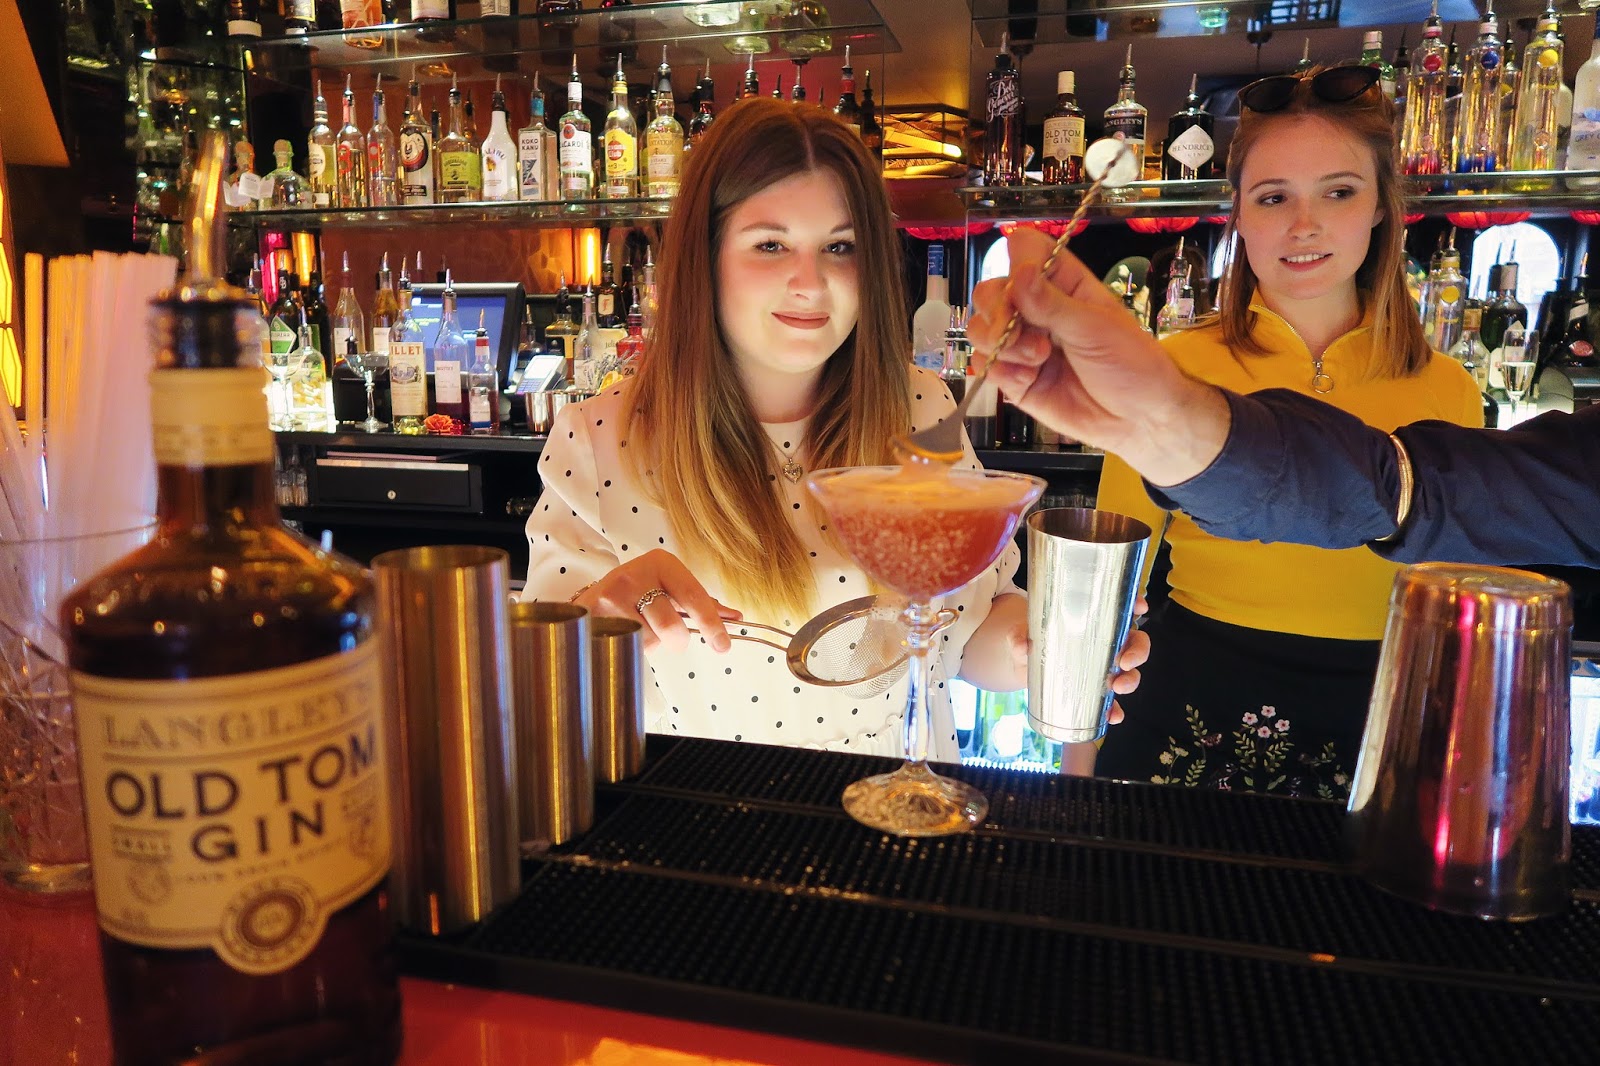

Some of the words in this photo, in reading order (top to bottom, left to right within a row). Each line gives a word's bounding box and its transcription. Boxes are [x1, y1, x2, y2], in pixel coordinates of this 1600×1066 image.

[1104, 118, 1143, 128] ANGLEY'S
[1045, 129, 1060, 139] OLD
[1062, 129, 1081, 138] TOM
[391, 345, 421, 355] ILLET
[624, 367, 635, 376] 24
[104, 769, 241, 821] OLD
[258, 720, 377, 805] TOM
[190, 801, 325, 864] GIN
